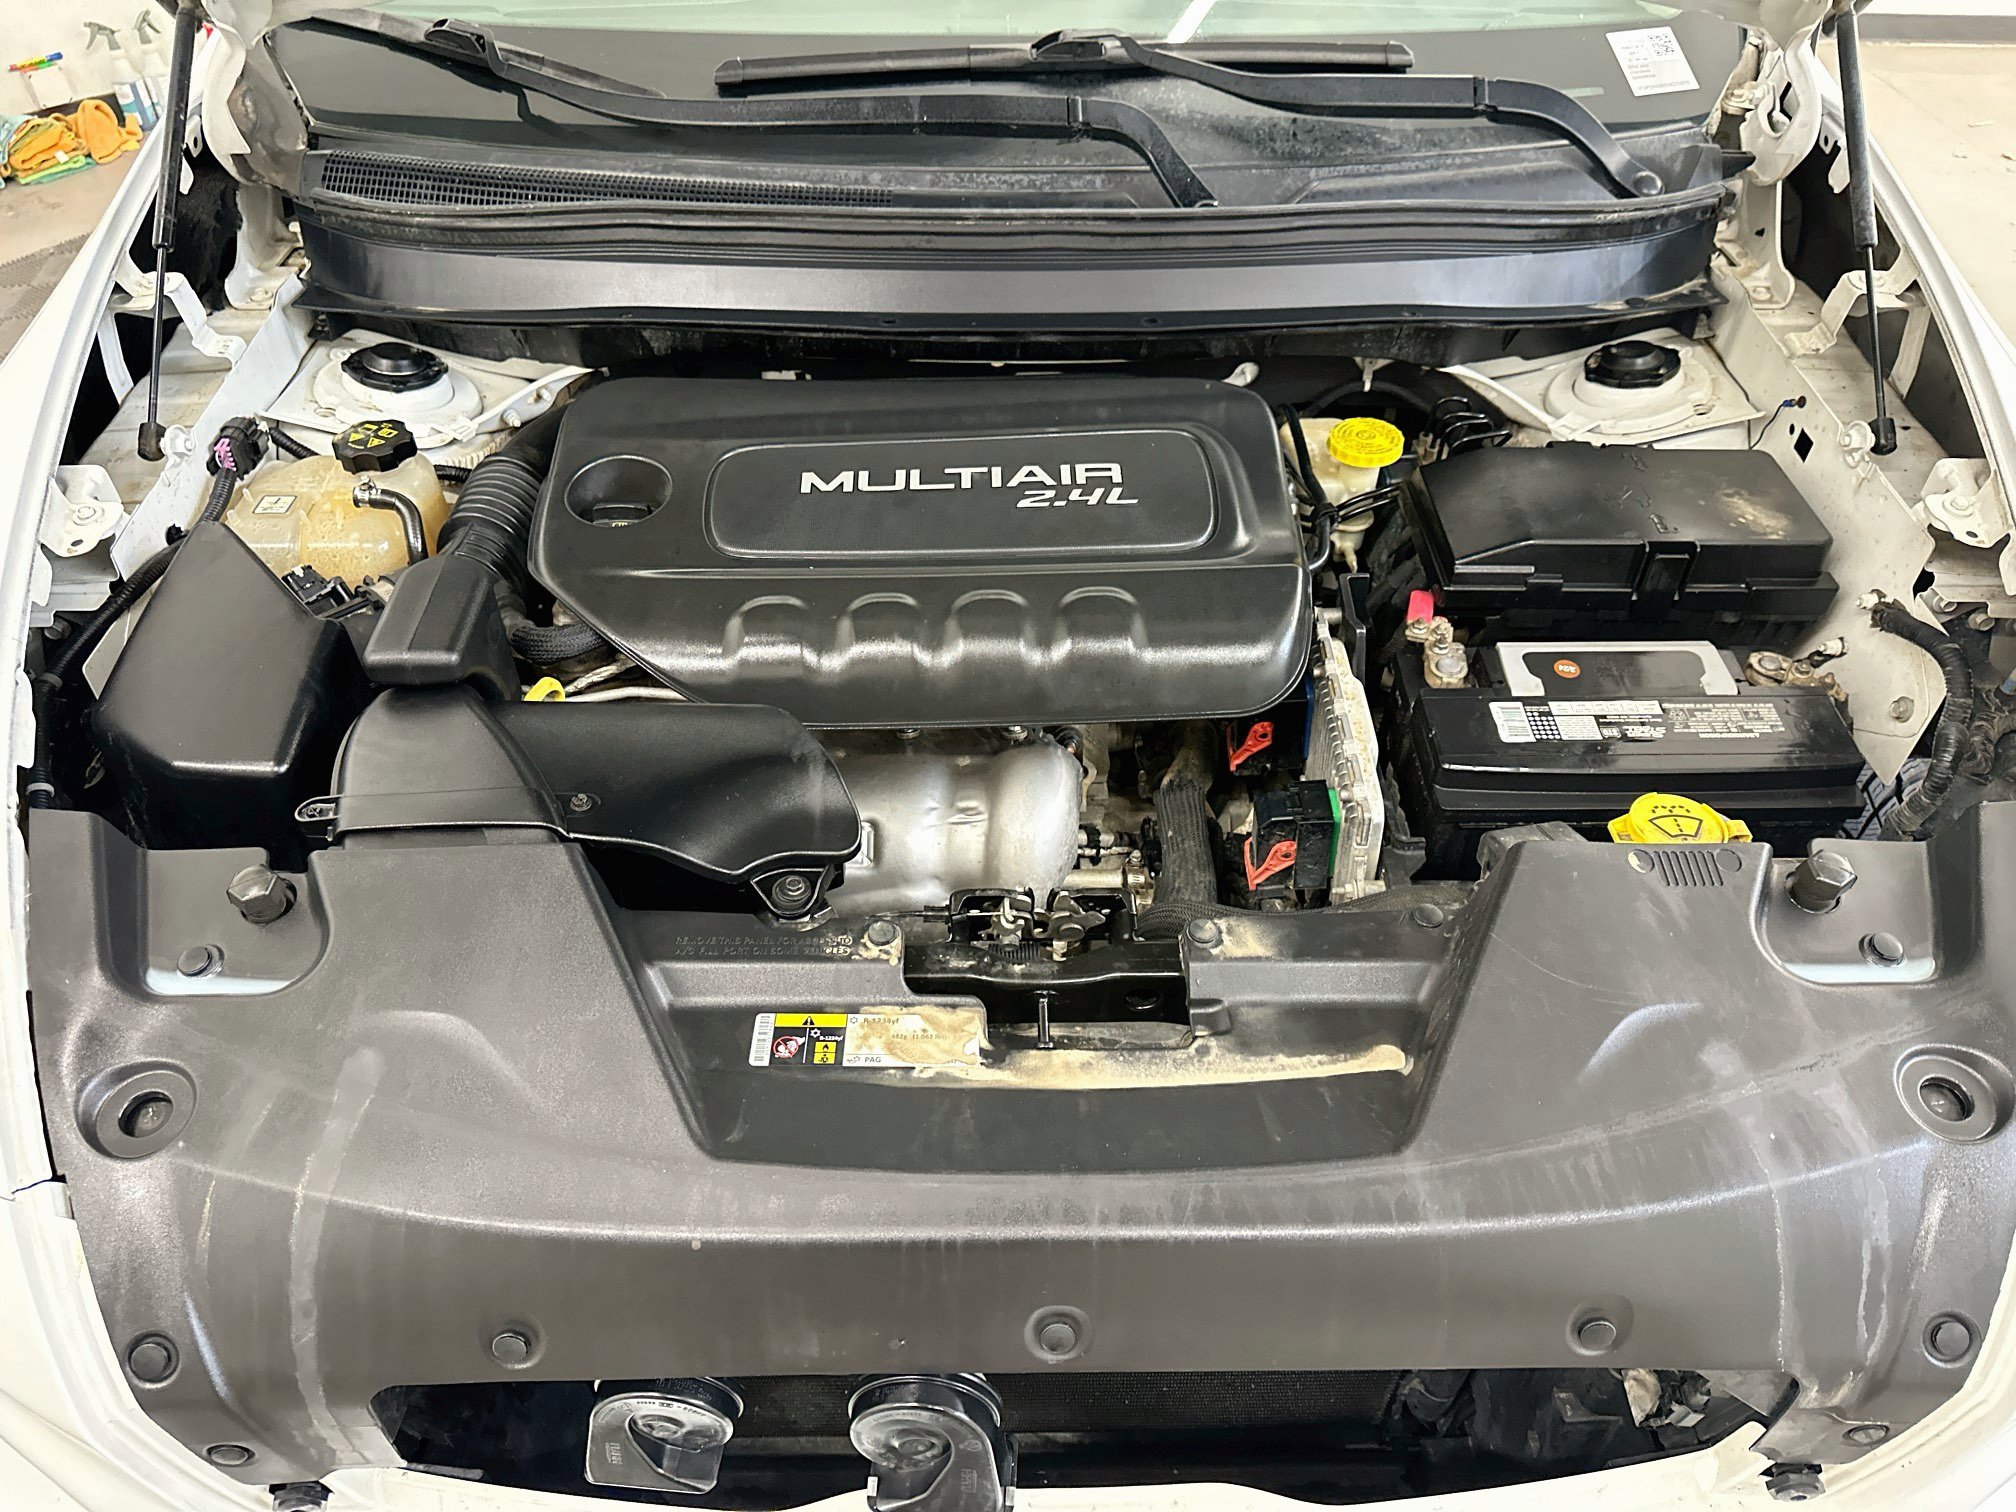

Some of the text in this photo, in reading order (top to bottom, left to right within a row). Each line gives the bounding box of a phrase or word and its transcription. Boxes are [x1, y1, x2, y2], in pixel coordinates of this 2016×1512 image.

[800, 463, 1124, 494] MULTIAIR
[1016, 487, 1140, 508] 2.4L
[719, 936, 741, 945] THIS
[743, 936, 774, 945] PANEL
[777, 936, 797, 945] FOR
[838, 935, 853, 946] TO
[699, 946, 720, 955] FILL
[863, 1017, 900, 1026] R-1234yf
